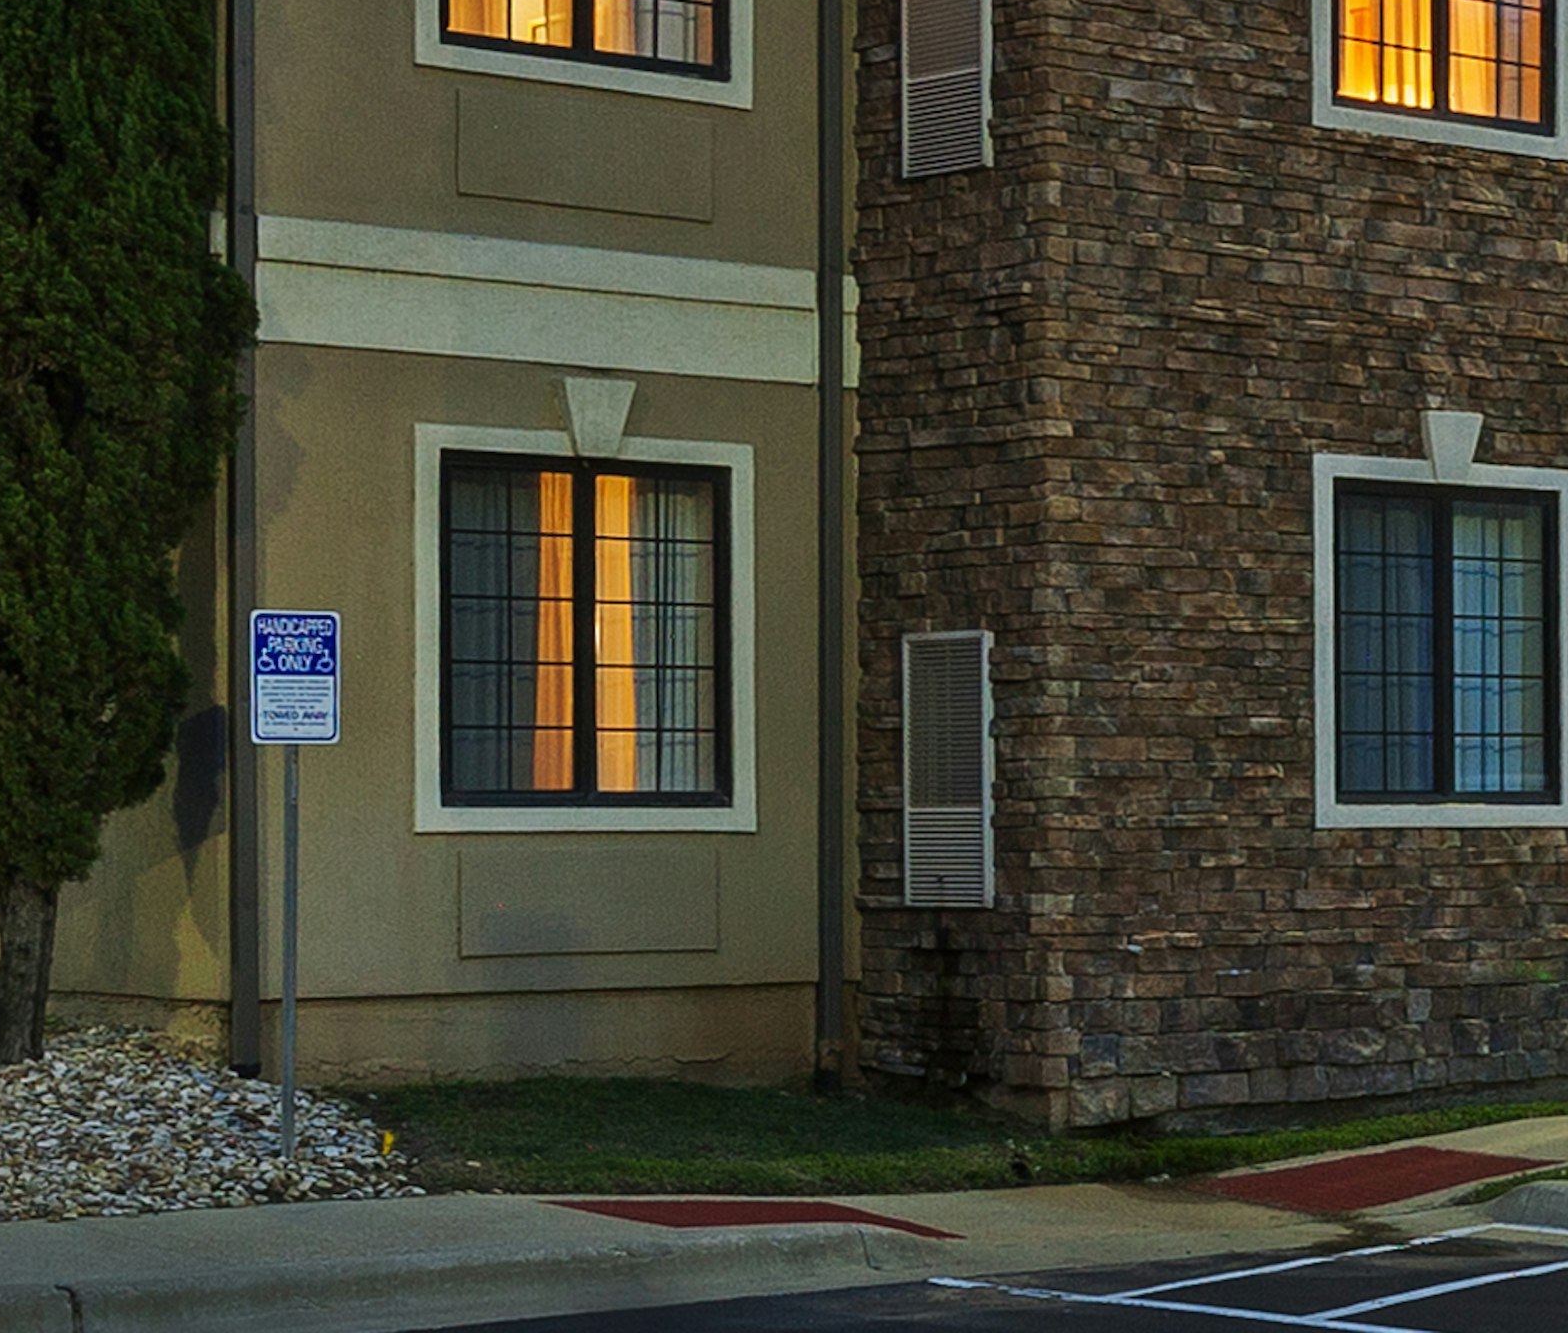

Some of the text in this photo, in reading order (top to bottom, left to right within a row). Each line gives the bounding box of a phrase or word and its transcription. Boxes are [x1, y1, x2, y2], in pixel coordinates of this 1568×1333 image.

[257, 618, 333, 636] HANDICAPPED
[267, 636, 324, 654] PARKING
[277, 655, 313, 672] ONLY
